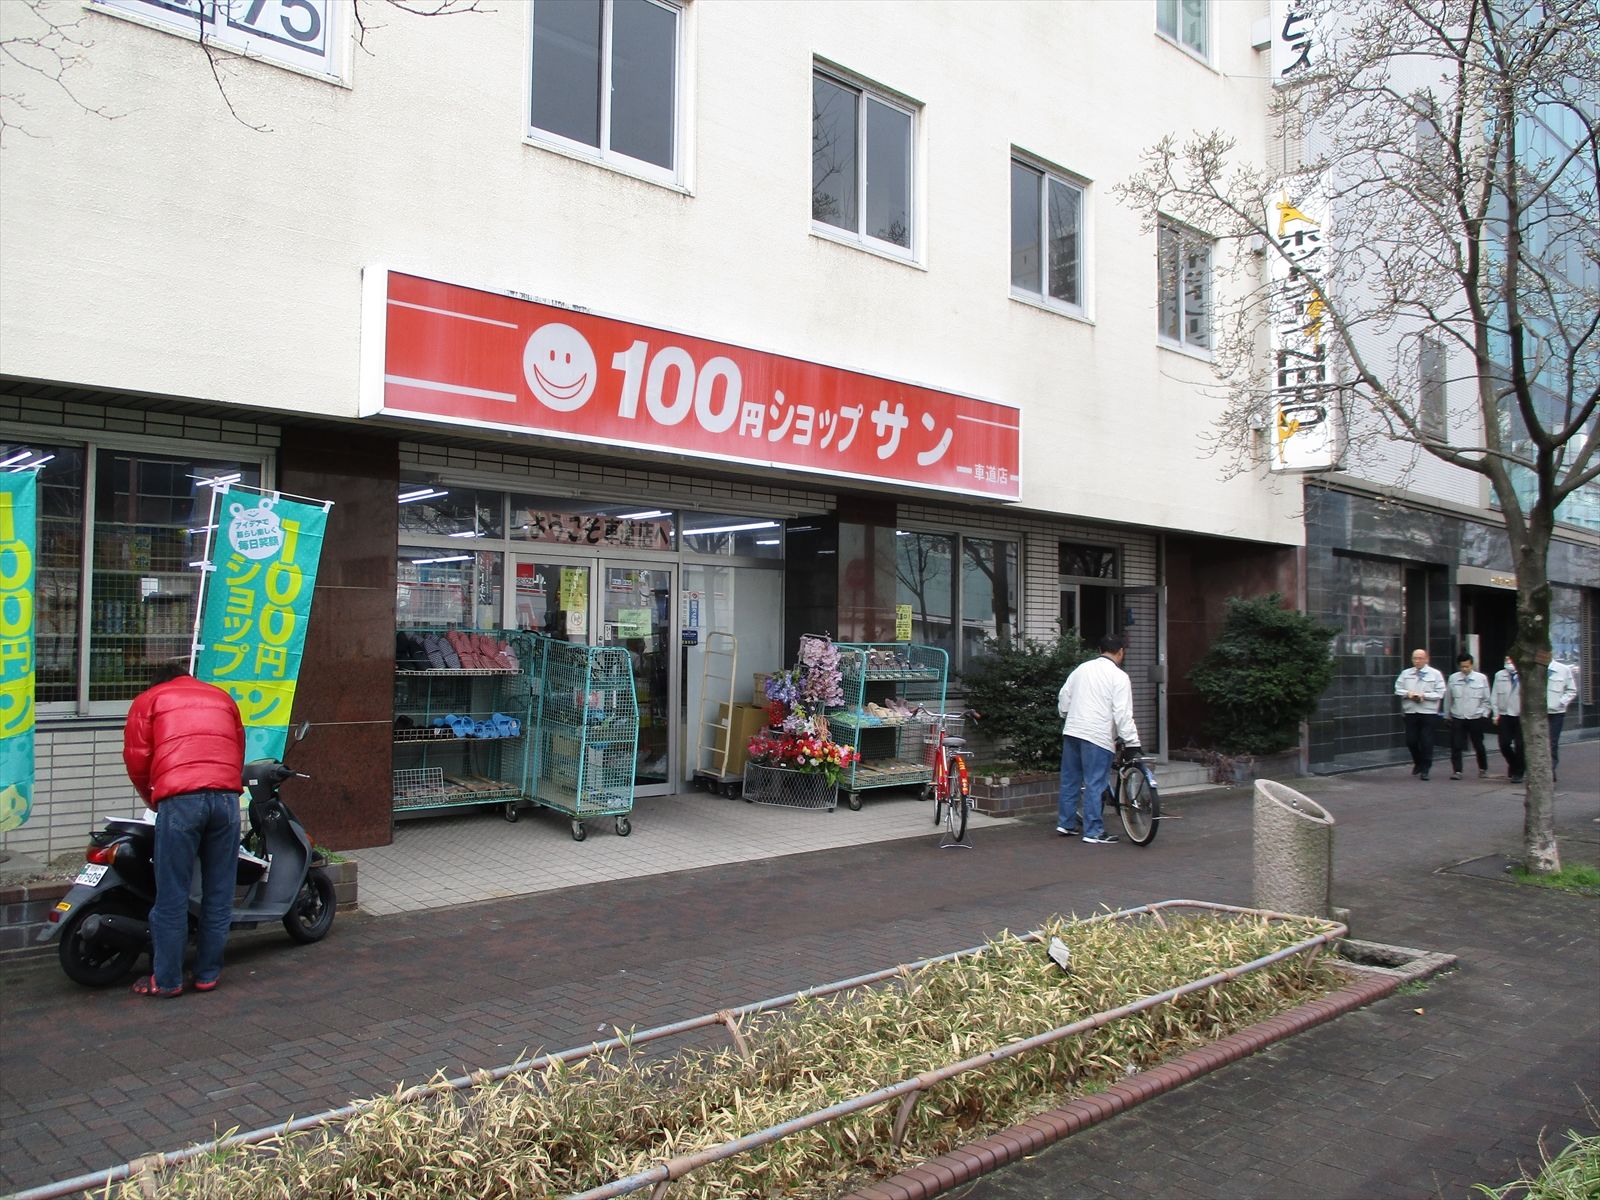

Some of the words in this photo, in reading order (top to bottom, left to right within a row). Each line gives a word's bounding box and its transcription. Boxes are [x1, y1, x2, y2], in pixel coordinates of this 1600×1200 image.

[974, 463, 1008, 485] 車道店
[235, 518, 269, 529] アイデアで
[236, 527, 278, 538] 暮らし楽しく
[238, 535, 279, 551] 毎日笑顔
[254, 518, 303, 678] 100円
[213, 553, 261, 677] ショップ
